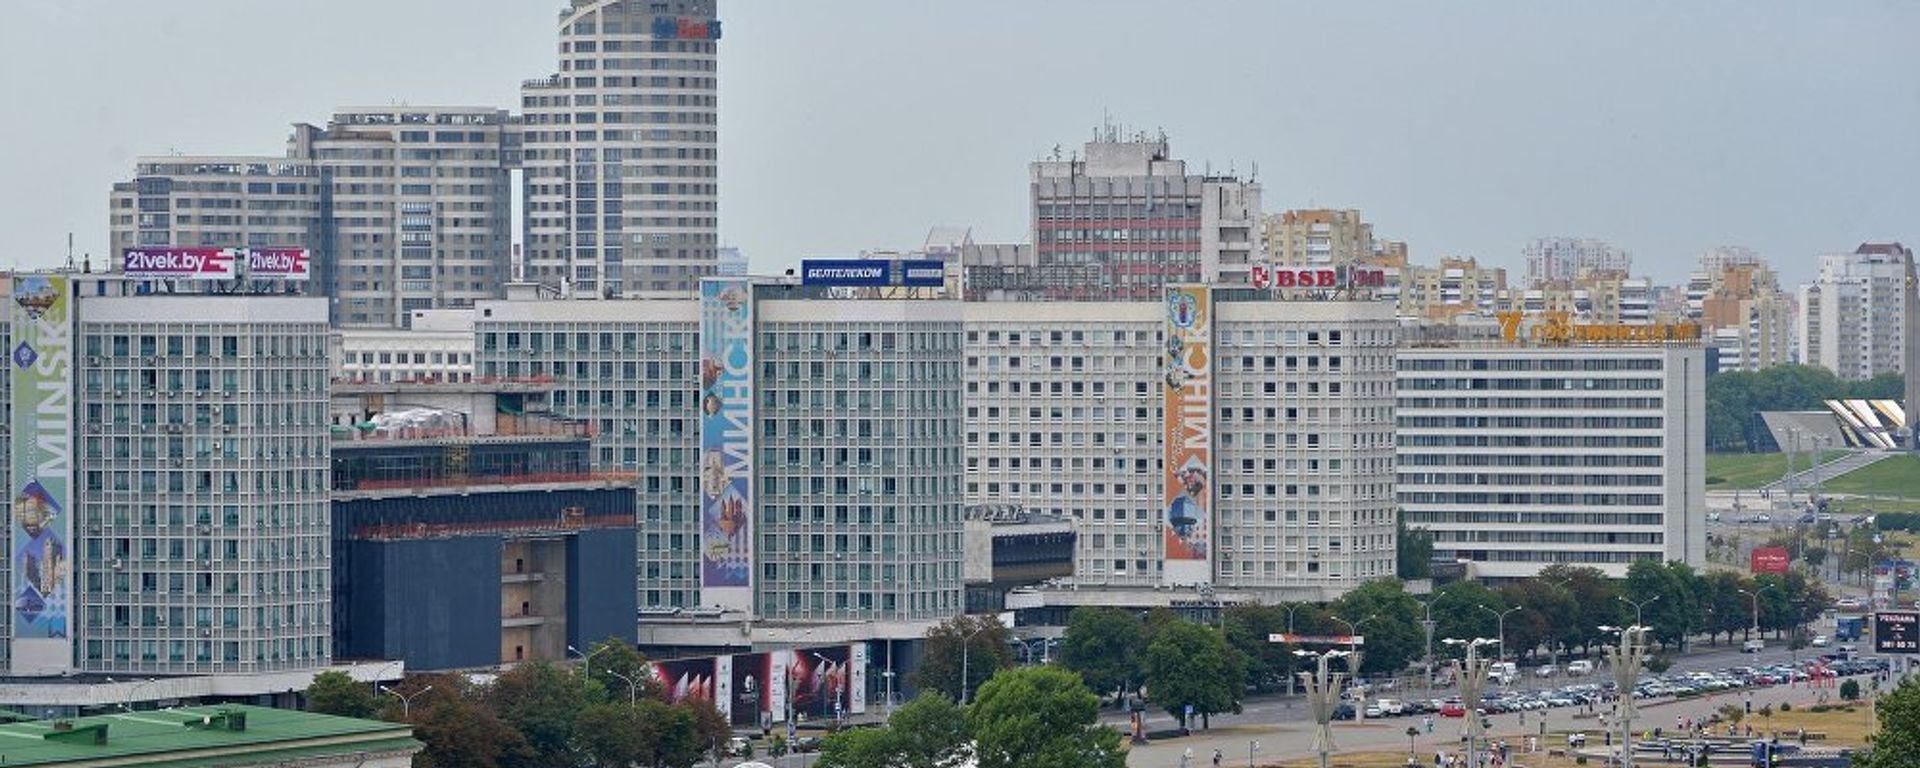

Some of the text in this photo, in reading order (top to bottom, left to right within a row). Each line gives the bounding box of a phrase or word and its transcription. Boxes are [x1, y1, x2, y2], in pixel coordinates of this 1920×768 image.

[127, 251, 206, 275] 21vek.by
[251, 251, 295, 274] 21vek.by
[1276, 270, 1336, 288] BSB
[35, 318, 68, 479] MINSK
[721, 313, 749, 479] МИНСК
